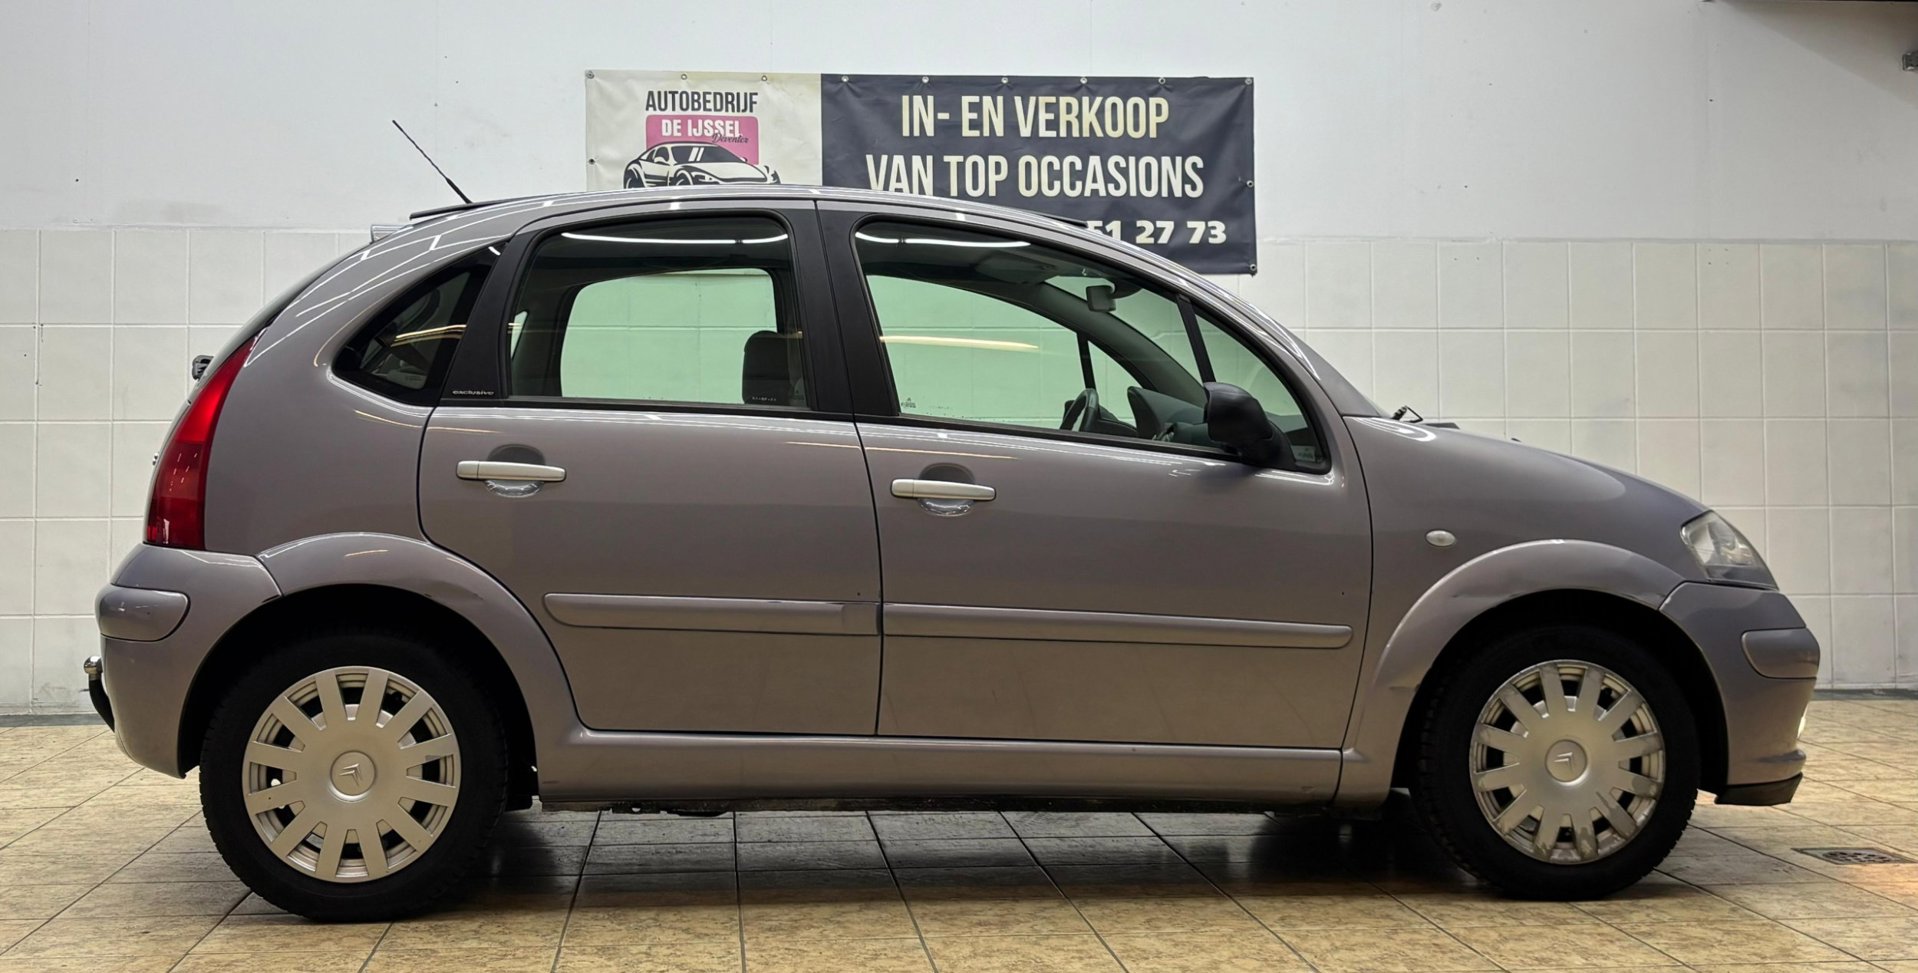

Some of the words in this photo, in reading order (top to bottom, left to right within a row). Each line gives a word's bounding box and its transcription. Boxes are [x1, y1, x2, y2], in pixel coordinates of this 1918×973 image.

[645, 90, 759, 113] AUTOBEDRIJF
[661, 119, 682, 137] DE
[687, 119, 741, 138] IJSSEL
[901, 95, 950, 137] IN-
[961, 95, 1003, 137] EN
[1014, 96, 1169, 139] VERKOOP
[711, 133, 750, 144] Deventer
[866, 154, 934, 196] VAN
[943, 154, 1008, 197] TOP
[1018, 155, 1205, 198] OCCASIONS
[1135, 220, 1175, 244] 27
[1186, 220, 1227, 244] 73
